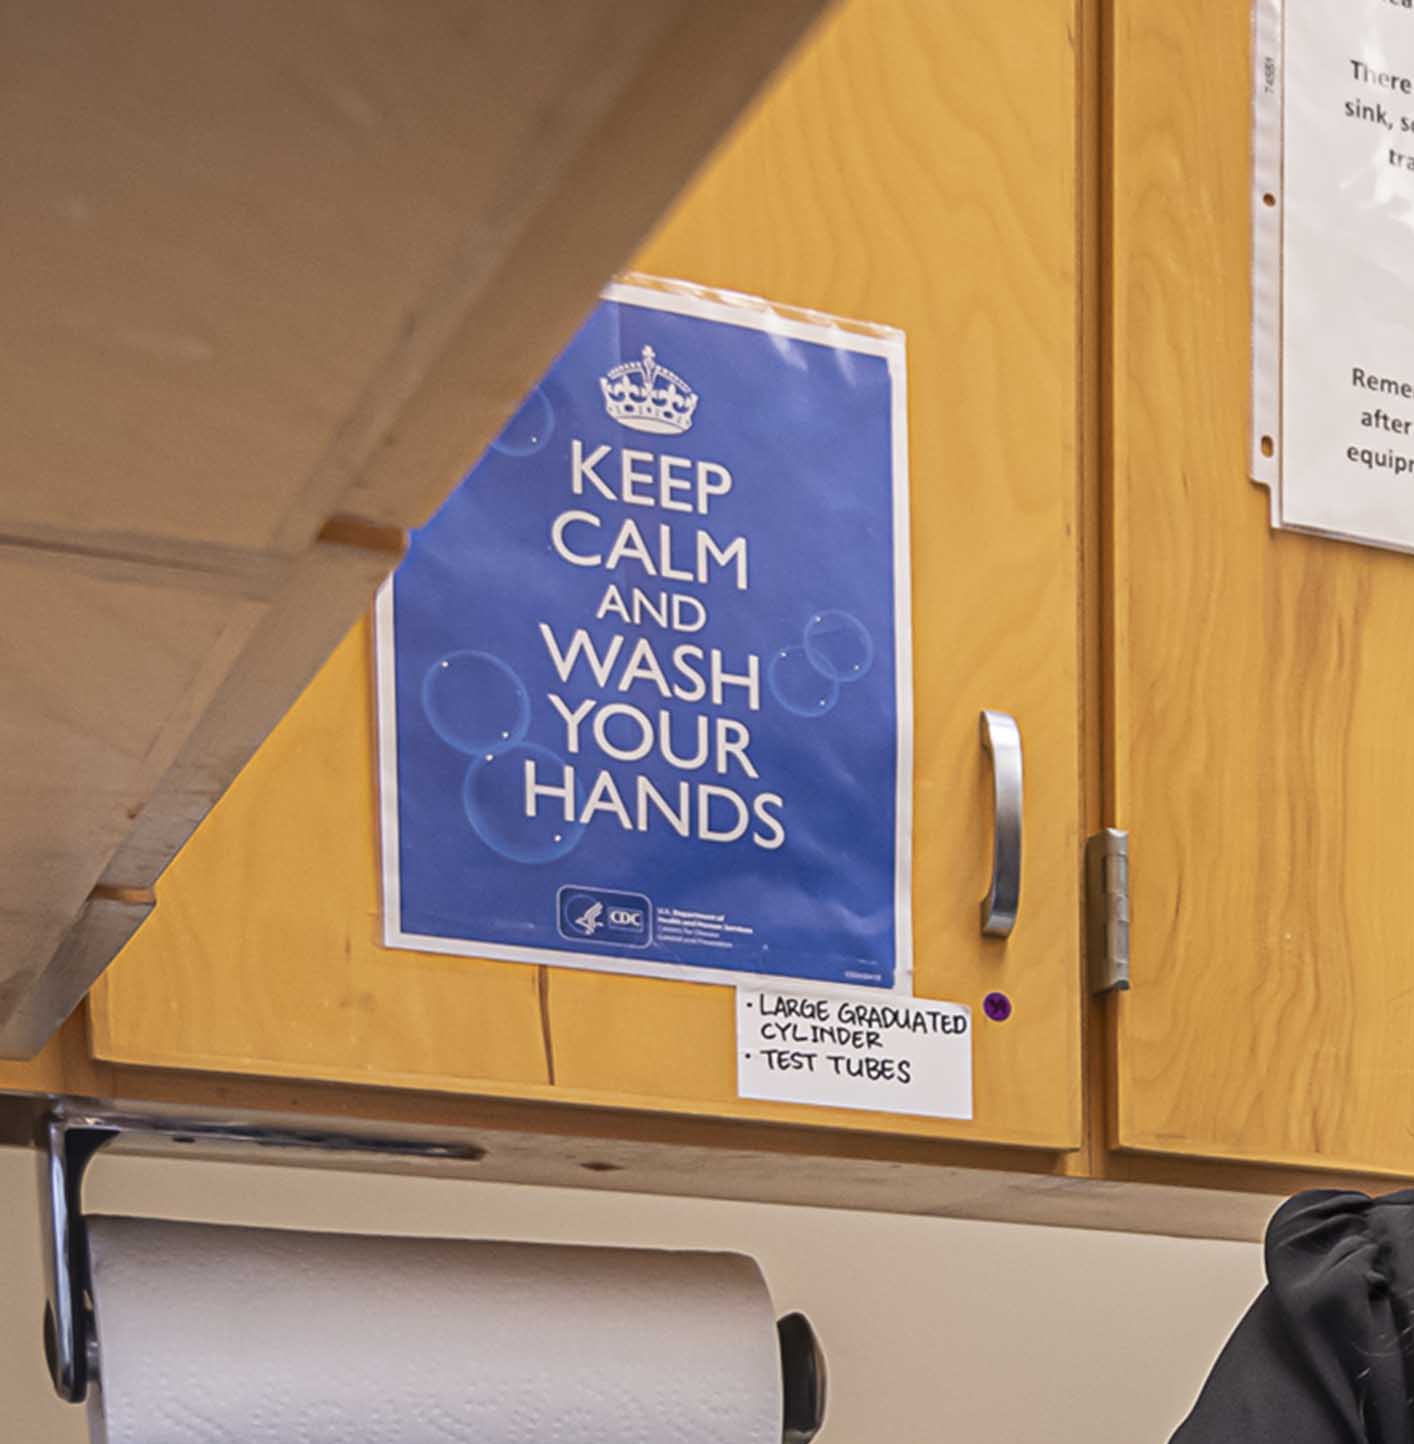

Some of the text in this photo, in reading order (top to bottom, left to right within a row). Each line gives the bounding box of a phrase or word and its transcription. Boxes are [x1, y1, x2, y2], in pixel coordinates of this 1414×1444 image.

[1350, 59, 1412, 94] There
[1345, 98, 1393, 130] sink,
[1361, 409, 1412, 435] after
[572, 439, 733, 515] KEEP
[552, 509, 748, 590] CALM
[597, 584, 707, 632] AND
[539, 623, 759, 710] WASH
[547, 693, 759, 779] YOUR
[524, 759, 785, 850] HANDS
[610, 910, 641, 927] CDC
[759, 993, 968, 1035] LARGE GRADUATED
[761, 1022, 884, 1049] CYLINDER
[760, 1049, 912, 1084] TEST TUBES
